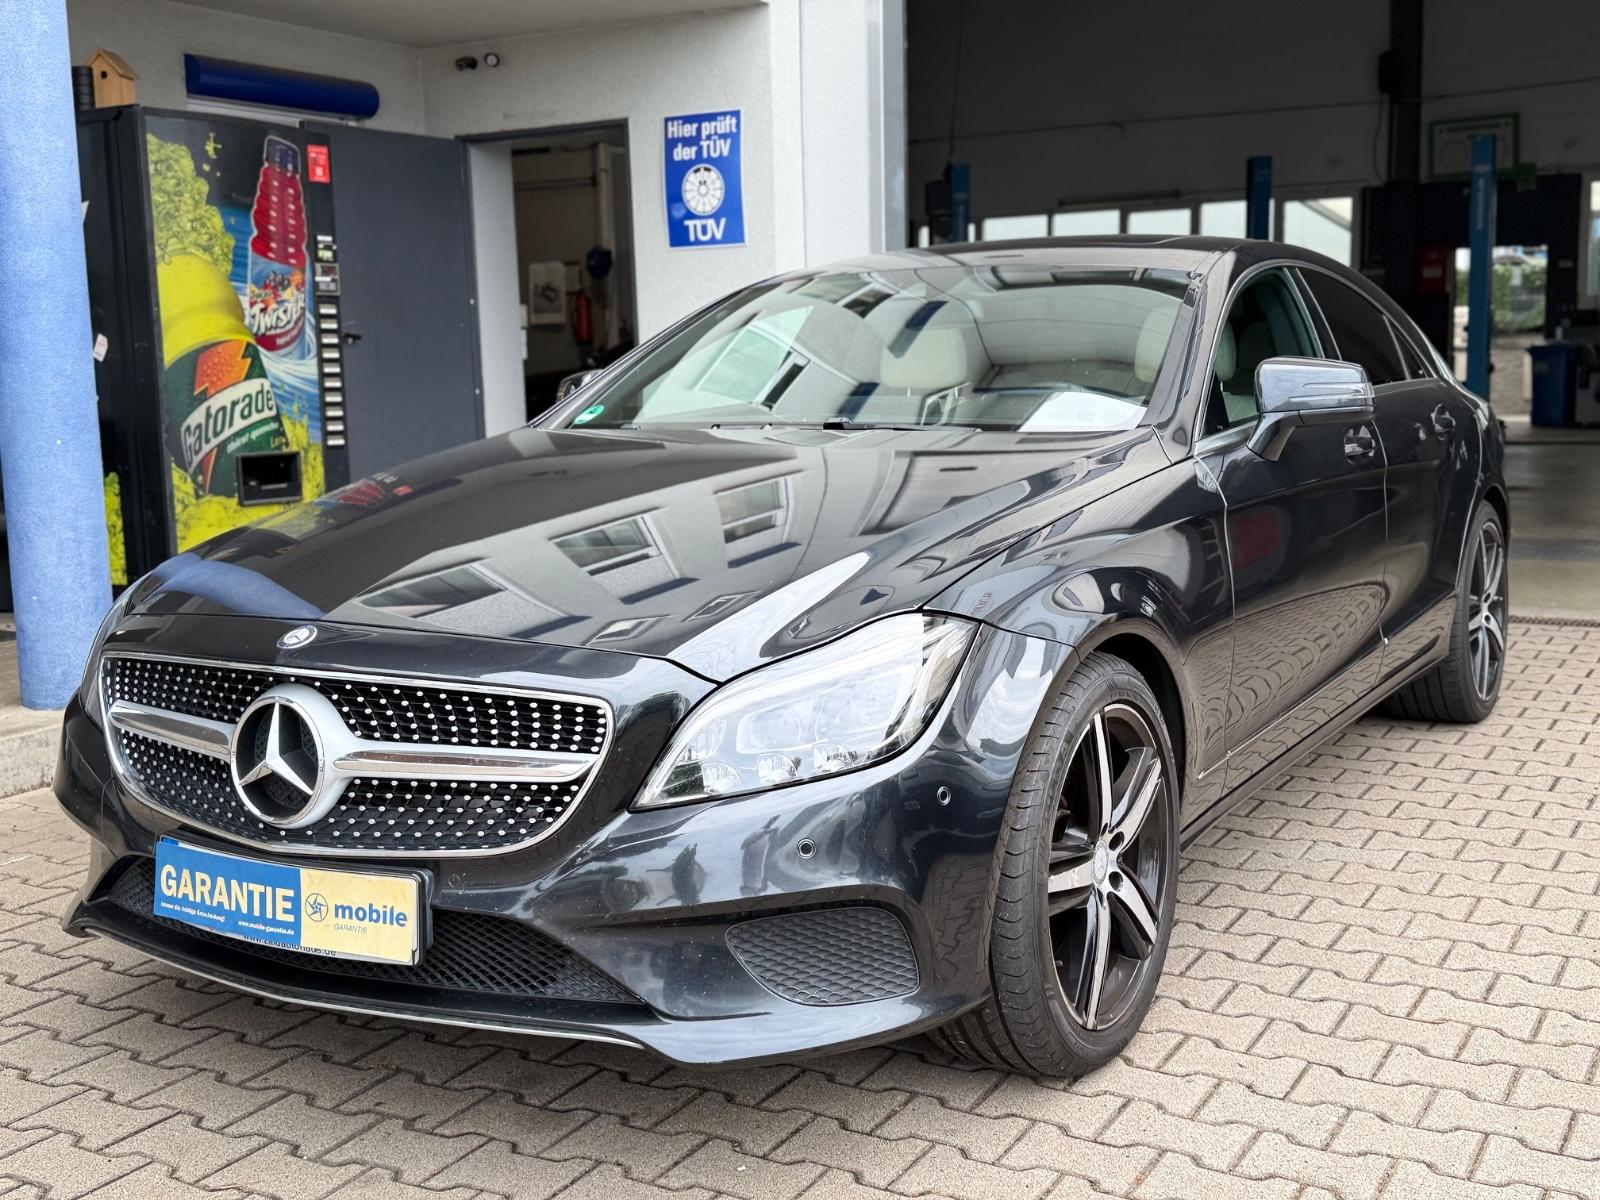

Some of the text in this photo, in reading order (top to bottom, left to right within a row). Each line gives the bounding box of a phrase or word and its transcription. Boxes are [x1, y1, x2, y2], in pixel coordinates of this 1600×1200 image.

[667, 115, 737, 140] Hier prüft
[673, 135, 731, 161] der TÜV
[184, 383, 274, 467] Gatorade
[160, 864, 295, 922] GARANTIE
[334, 903, 408, 927] mobile
[334, 923, 368, 934] GARANTIE
